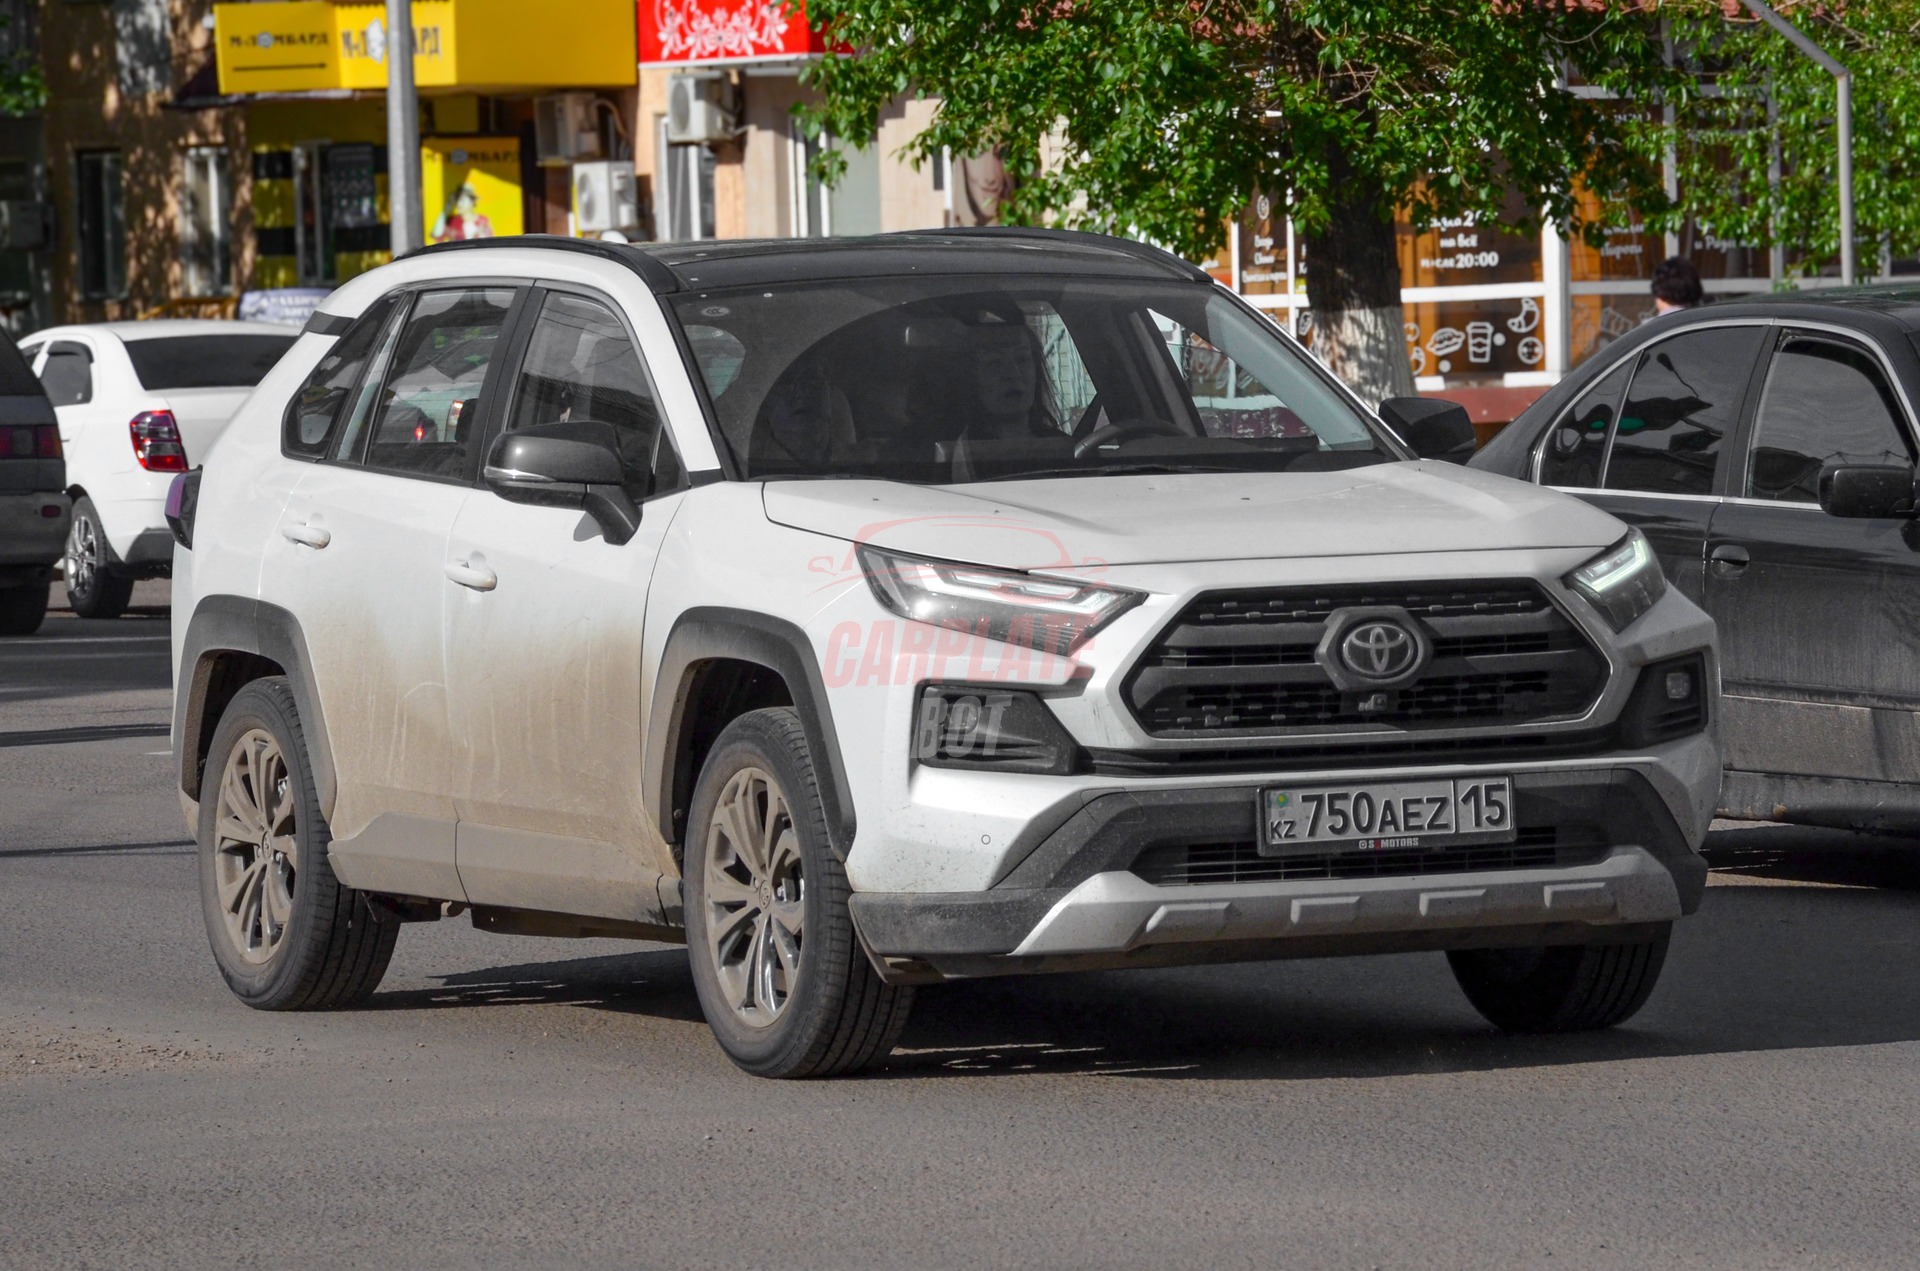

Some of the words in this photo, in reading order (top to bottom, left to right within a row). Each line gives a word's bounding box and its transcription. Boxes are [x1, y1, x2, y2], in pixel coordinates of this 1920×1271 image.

[1456, 251, 1499, 269] 20:00
[1270, 820, 1298, 840] KZ
[1300, 791, 1450, 837] 750AEZ
[1460, 783, 1507, 828] 15
